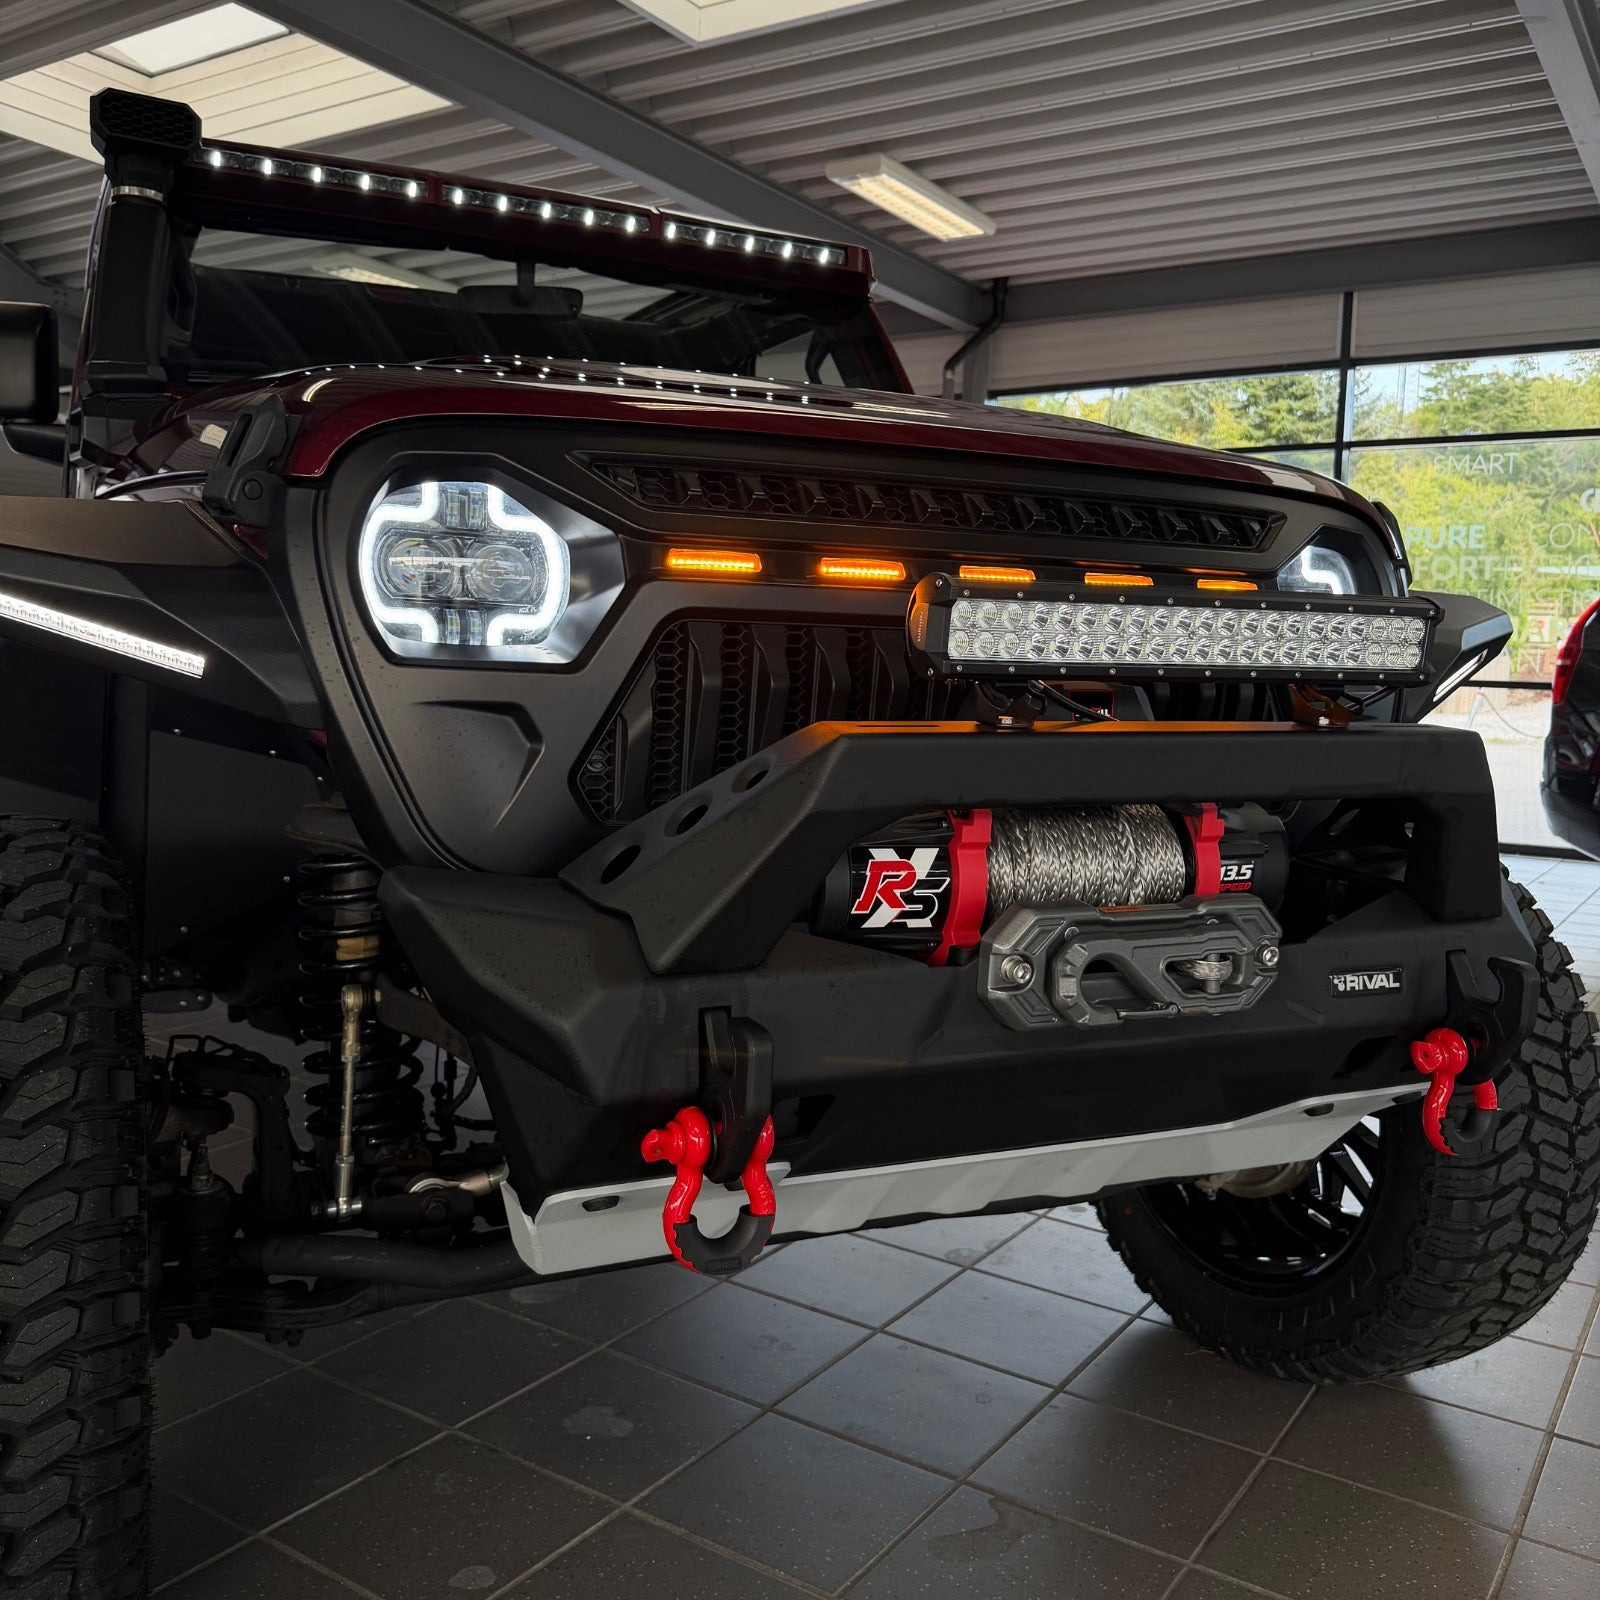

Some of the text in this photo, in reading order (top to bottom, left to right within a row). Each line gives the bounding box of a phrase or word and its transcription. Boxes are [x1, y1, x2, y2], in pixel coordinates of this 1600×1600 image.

[1433, 452, 1520, 478] SMART
[1404, 524, 1486, 550] PURE
[1219, 864, 1254, 881] 13.5
[1346, 973, 1400, 991] RIVAL
